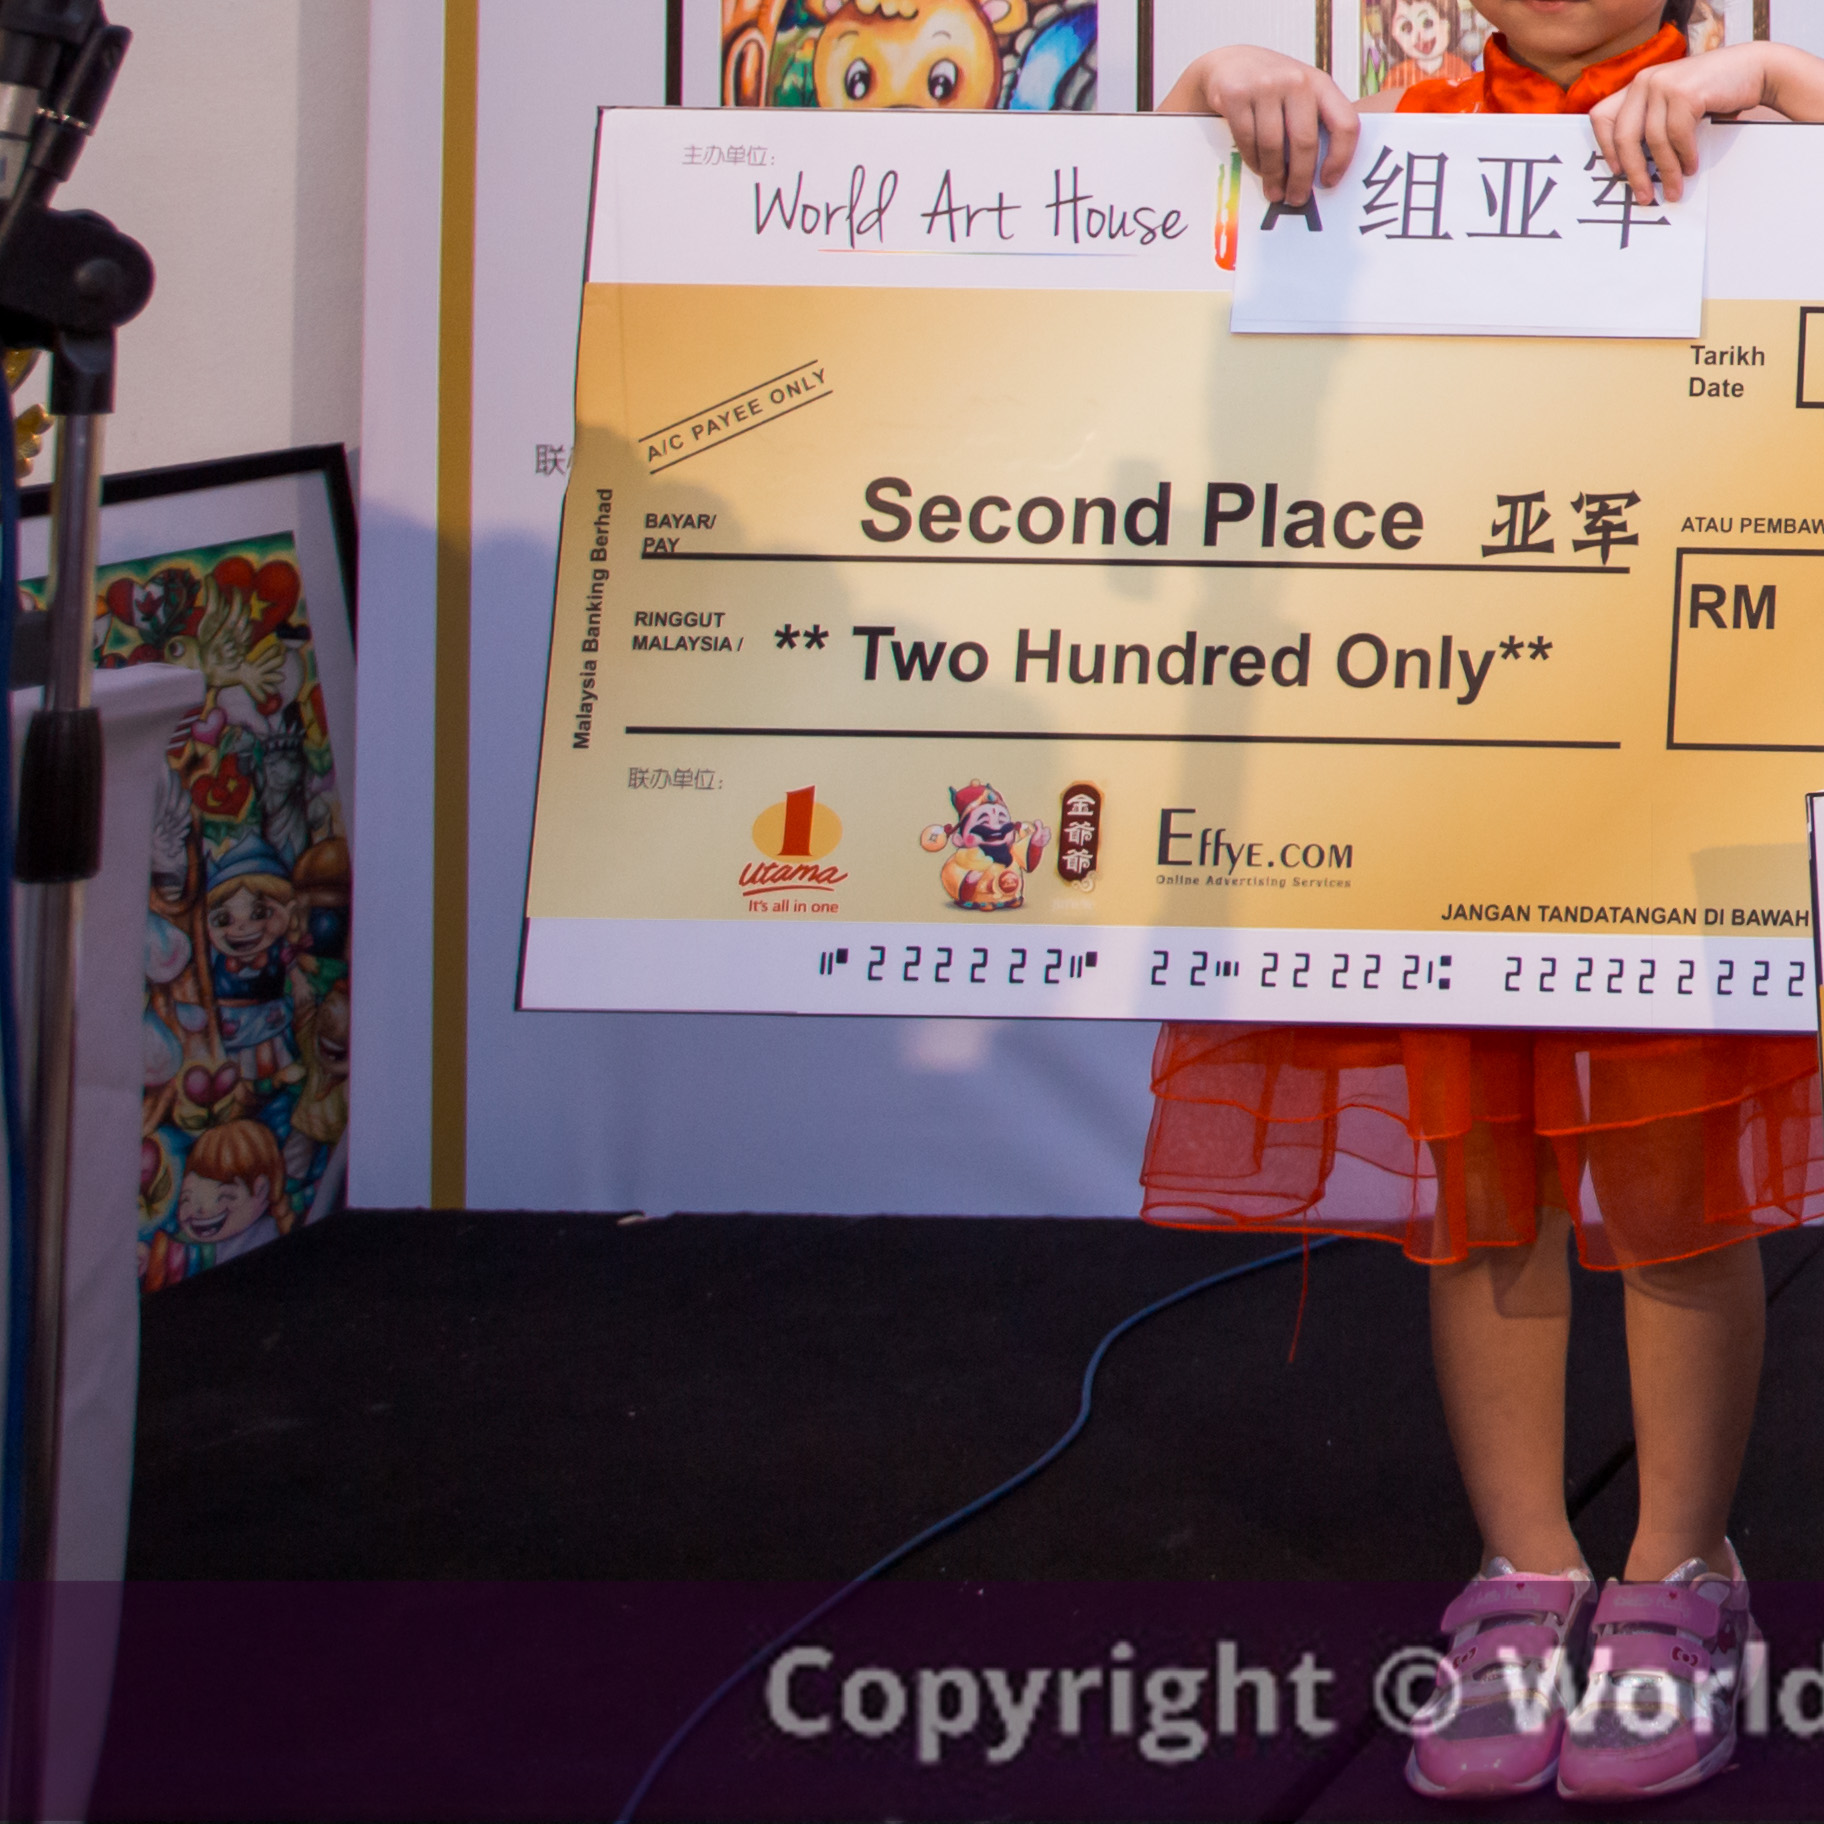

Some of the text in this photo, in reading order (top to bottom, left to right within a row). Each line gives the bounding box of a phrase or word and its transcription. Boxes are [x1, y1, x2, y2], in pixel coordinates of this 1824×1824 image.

[752, 163, 1189, 249] World Art House
[1690, 345, 1766, 367] Tarikh
[1689, 377, 1745, 399] Date
[649, 367, 828, 462] A/C PAYEE ONLY
[645, 513, 717, 529] BAYAR/
[860, 477, 1425, 551] Second Place
[1481, 490, 1640, 565] 亚军
[1680, 517, 1734, 535] ATAU
[572, 488, 613, 749] Malaysia Banking Berhad
[1688, 584, 1776, 630] RM
[634, 611, 725, 630] RINGGUT
[632, 634, 733, 652] MALAYSIA
[853, 624, 989, 683] Two
[1014, 629, 1311, 687] Hundred
[1292, 877, 1351, 887] Services
[772, 899, 790, 912] all
[793, 899, 807, 913] in
[811, 902, 839, 913] one
[1441, 903, 1809, 928] JANGAN TANDATANGAN DI BAWAH
